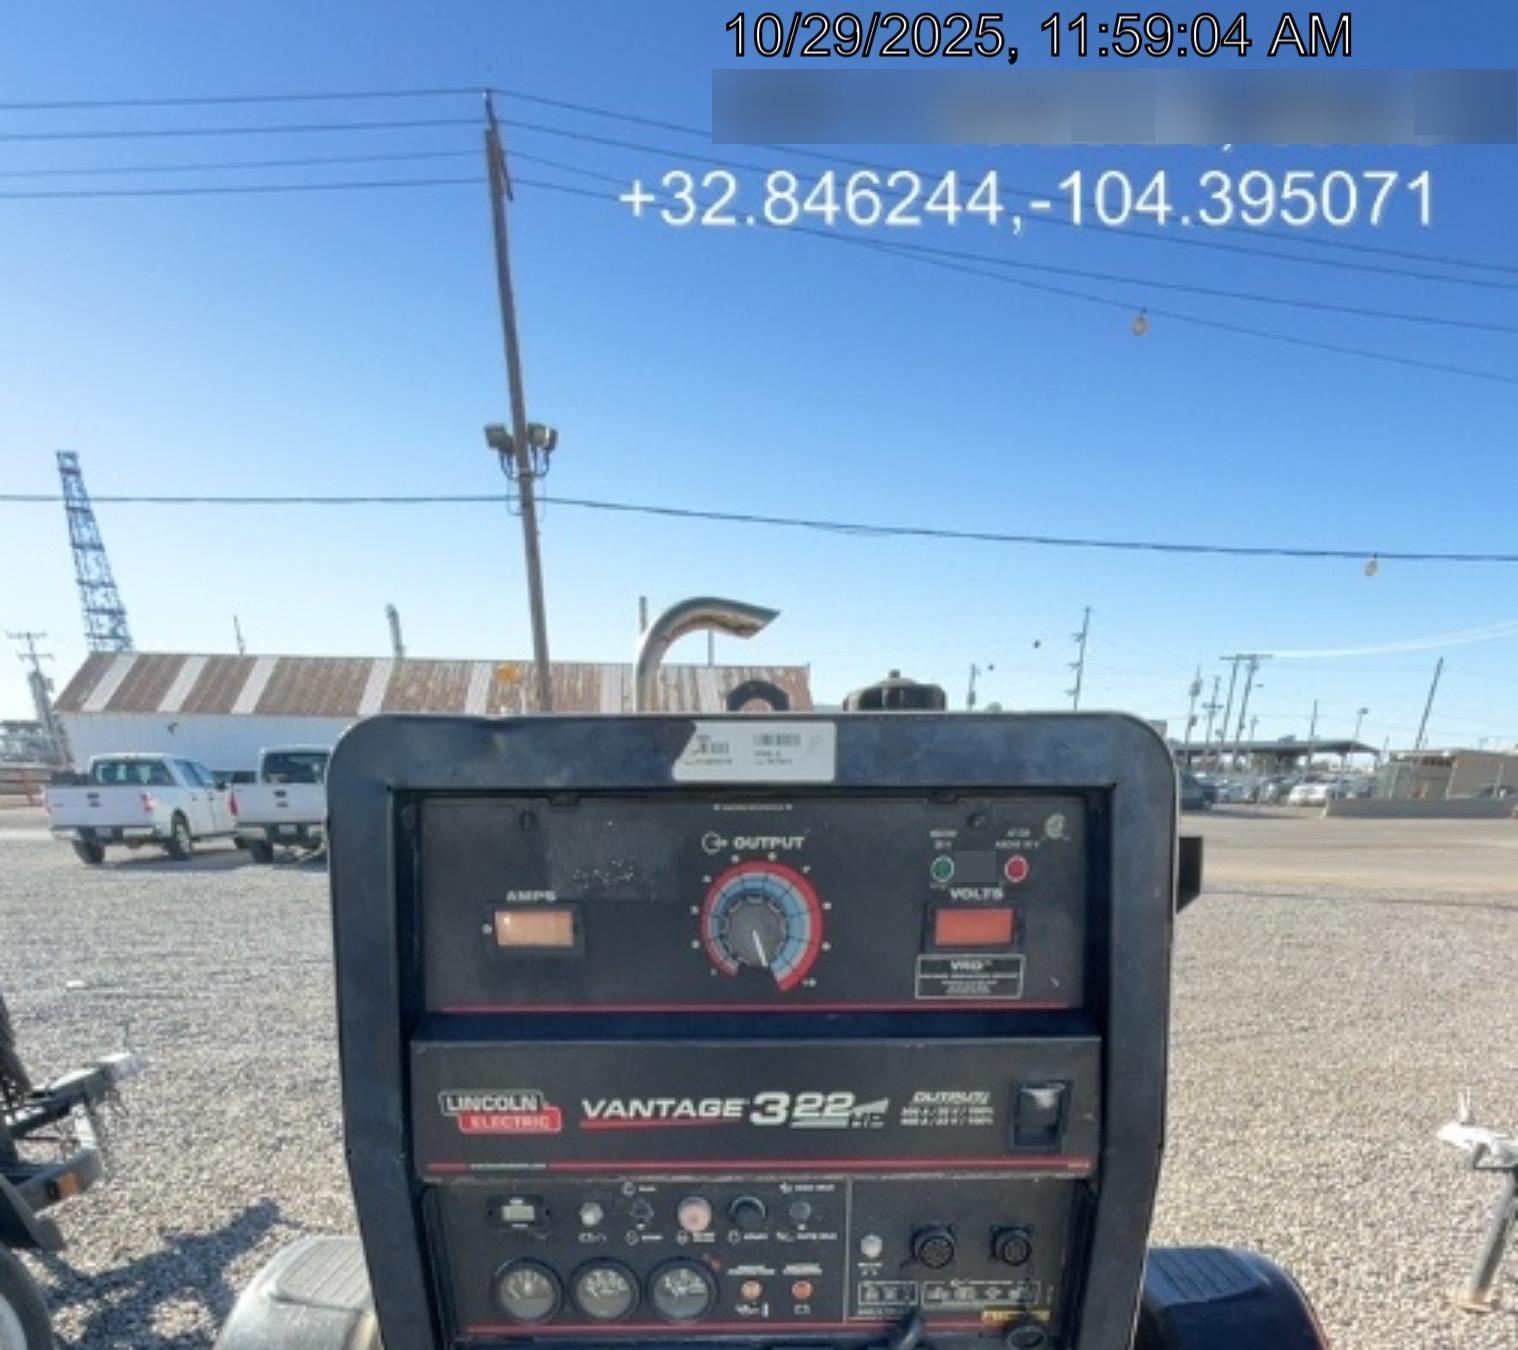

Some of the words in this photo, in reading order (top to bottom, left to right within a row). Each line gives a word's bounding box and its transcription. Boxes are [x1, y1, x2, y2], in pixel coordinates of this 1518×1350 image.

[732, 836, 805, 850] OUTPUT
[506, 890, 557, 902] AMPS
[949, 887, 1004, 900] VOLTS
[446, 1096, 538, 1111] LINCOLN
[581, 1098, 746, 1118] VANTAGE
[749, 1091, 855, 1126] 322
[470, 1115, 549, 1129] ELECTRIC
